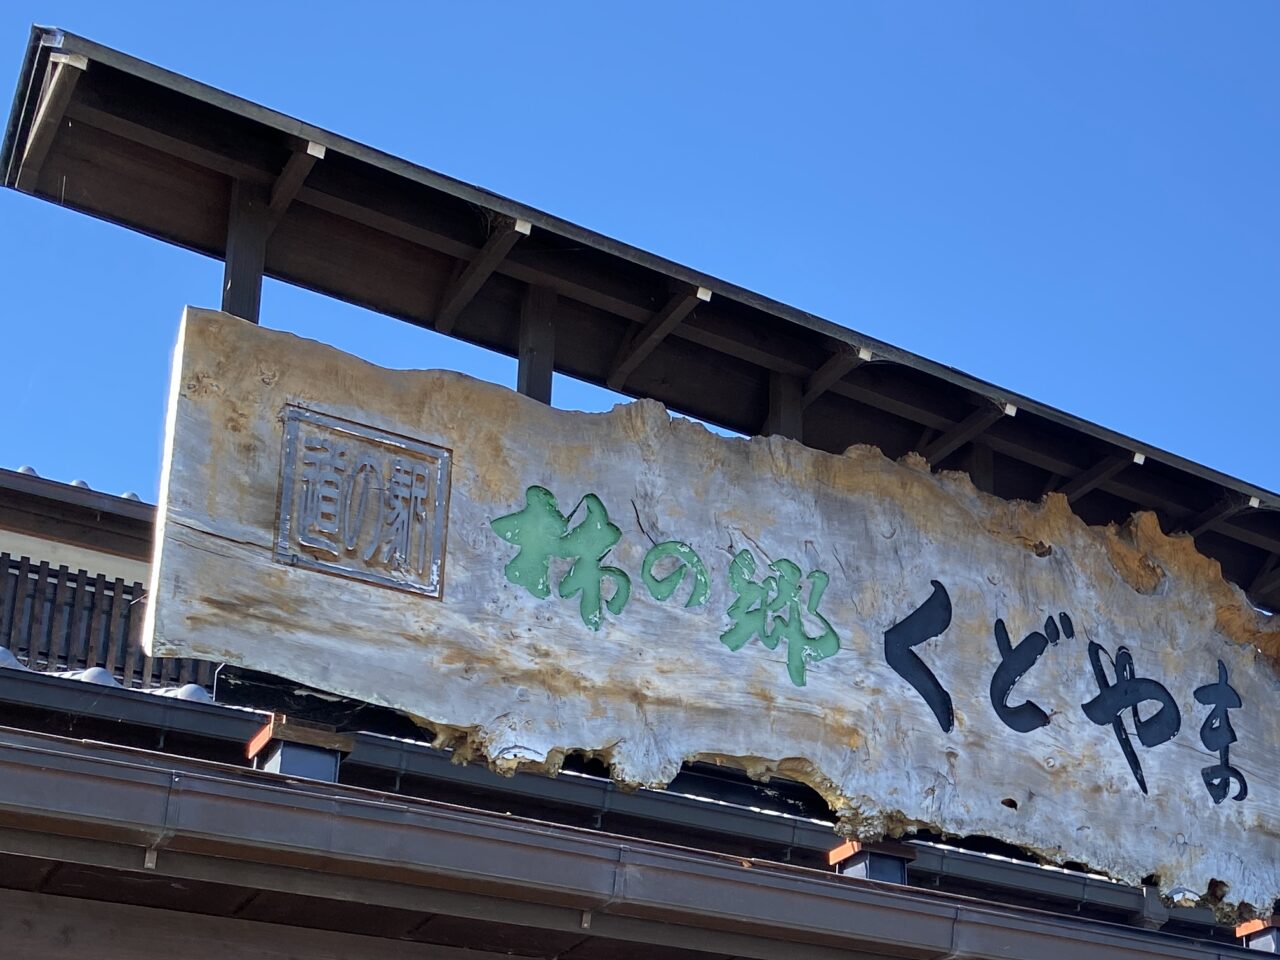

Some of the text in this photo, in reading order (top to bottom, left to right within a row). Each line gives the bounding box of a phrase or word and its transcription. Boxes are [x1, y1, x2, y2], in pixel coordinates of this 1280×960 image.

[297, 434, 432, 577] 道の駅
[490, 485, 1249, 805] 柿の郷 くどやま
